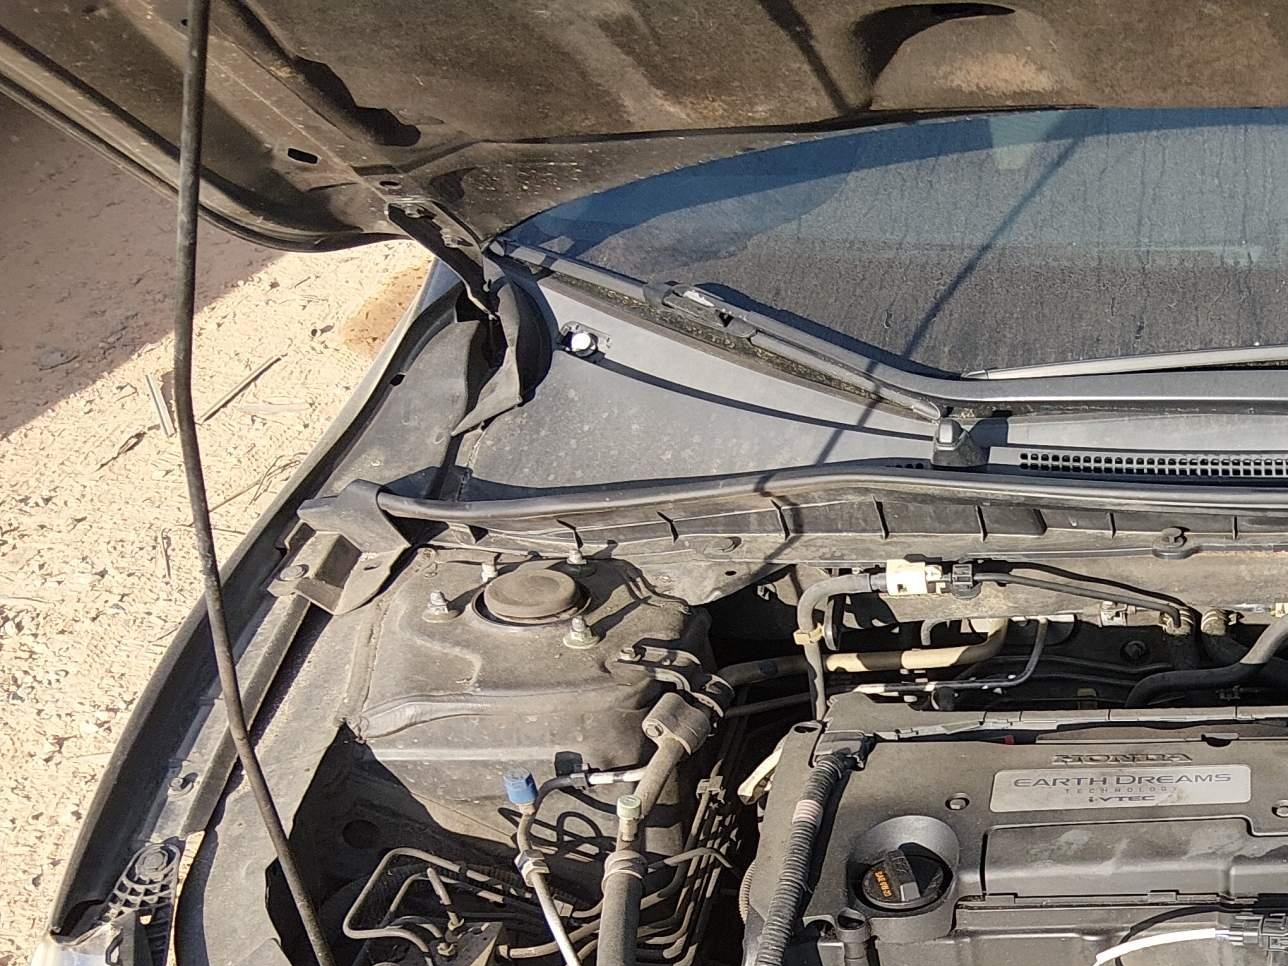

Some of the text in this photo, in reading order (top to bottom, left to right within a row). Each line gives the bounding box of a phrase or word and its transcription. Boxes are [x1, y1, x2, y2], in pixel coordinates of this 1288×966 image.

[1053, 754, 1191, 764] HONDA
[1014, 774, 1232, 787] EARTH DREAMS
